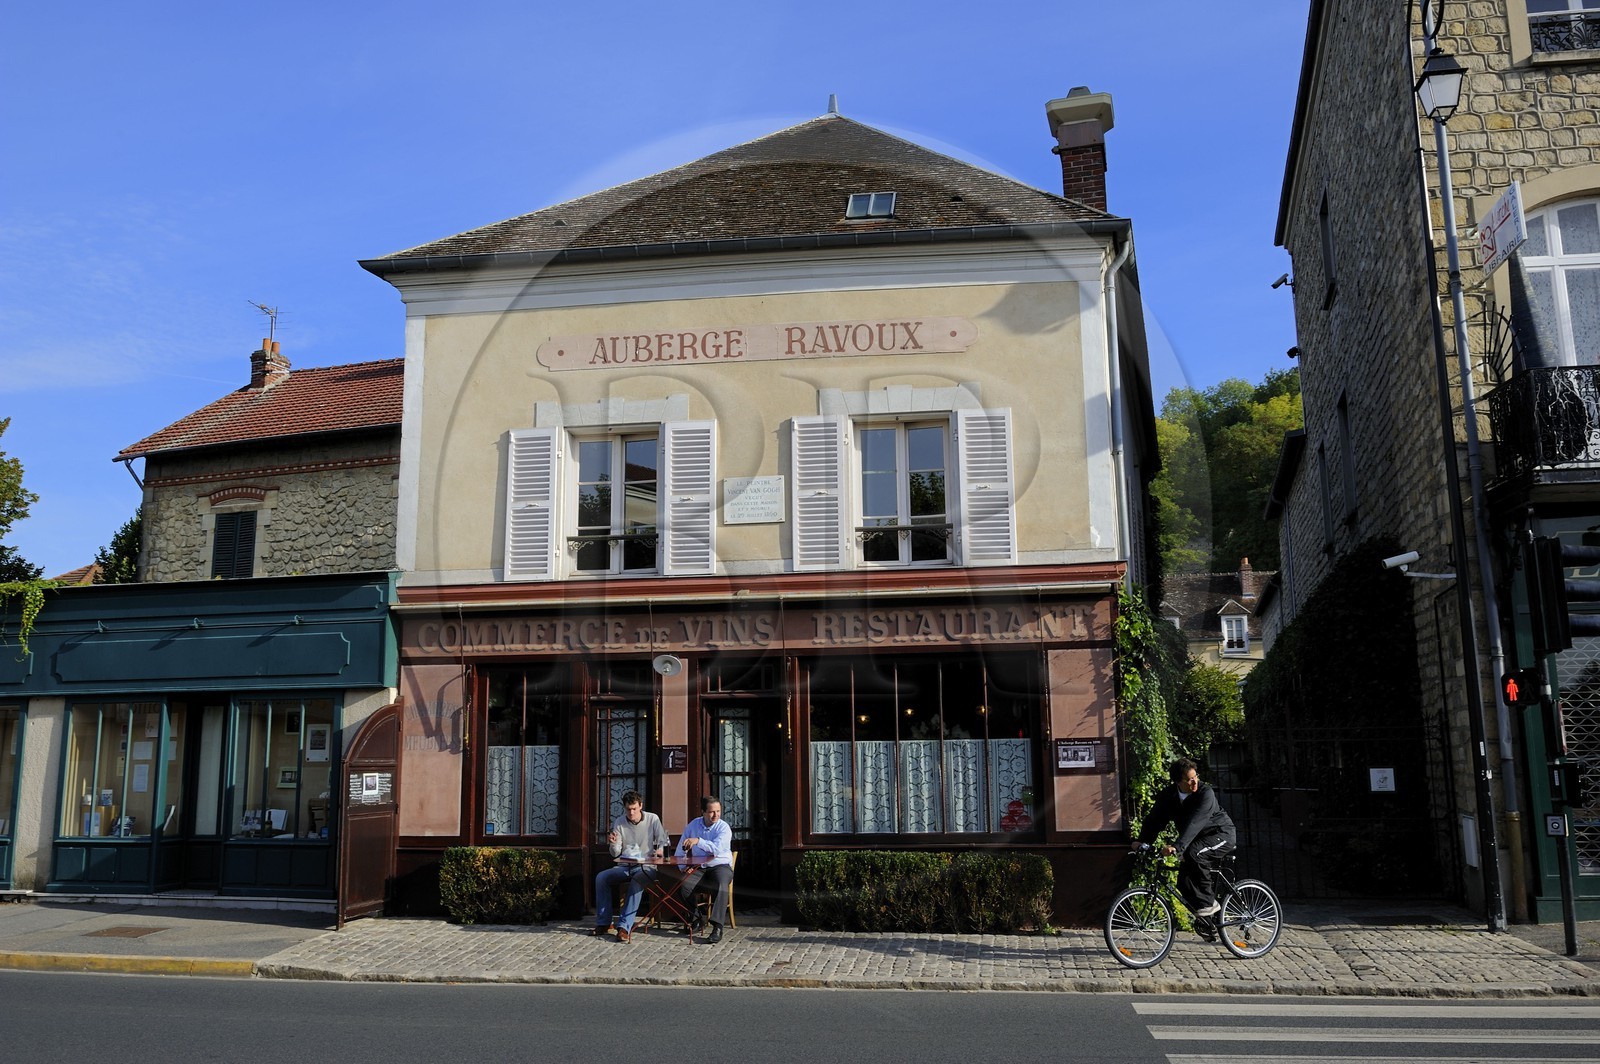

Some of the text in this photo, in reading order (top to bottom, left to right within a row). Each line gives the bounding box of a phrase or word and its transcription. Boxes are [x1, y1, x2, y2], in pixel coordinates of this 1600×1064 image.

[1484, 233, 1522, 276] LIBRAIRIE
[589, 322, 923, 365] AUBERGE RAVOUX
[418, 605, 1091, 653] COMMERCE DE VINS RESTAURANT
